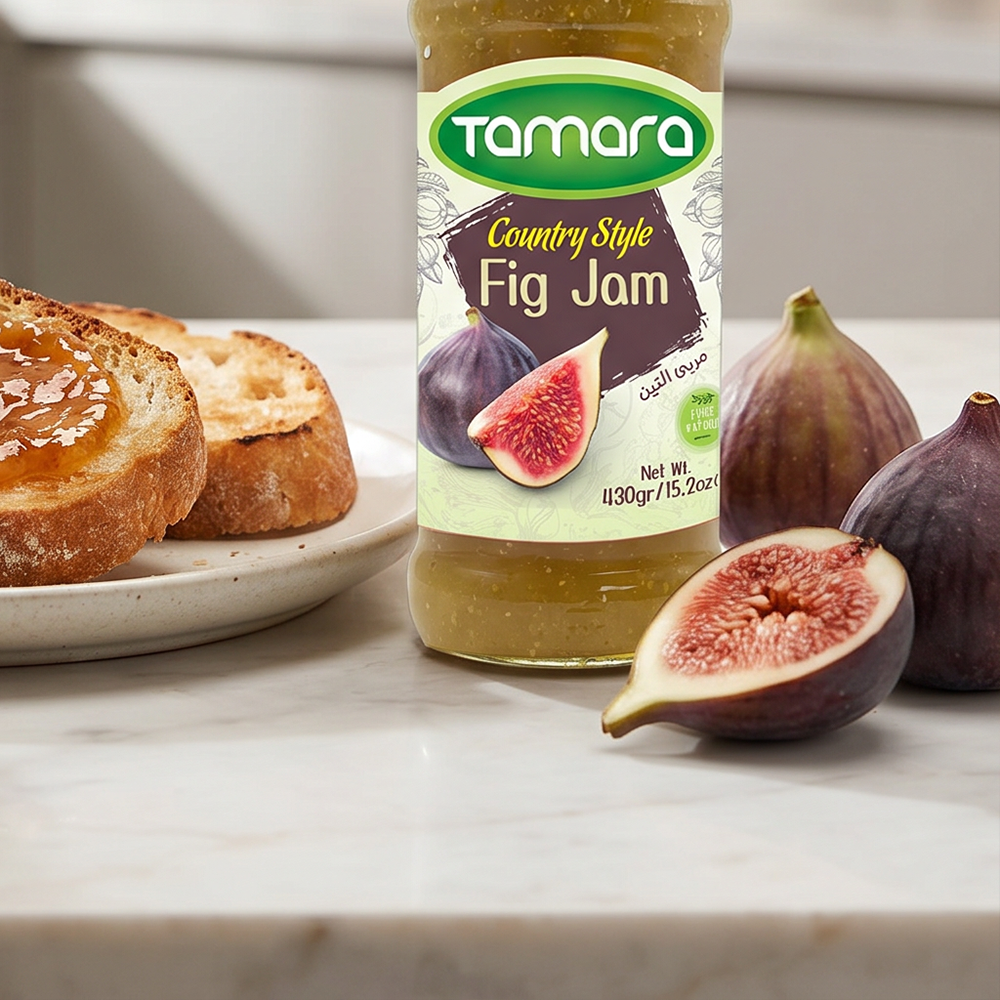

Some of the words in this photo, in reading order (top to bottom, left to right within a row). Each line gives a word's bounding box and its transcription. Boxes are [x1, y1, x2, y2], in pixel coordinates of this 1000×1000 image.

[451, 115, 694, 158] Tamara
[488, 217, 588, 260] Country
[591, 217, 654, 259] Style
[479, 257, 548, 319] Fig
[571, 258, 669, 307] Jam
[639, 369, 672, 401] التين
[640, 463, 665, 481] Net
[671, 461, 692, 476] Wt.
